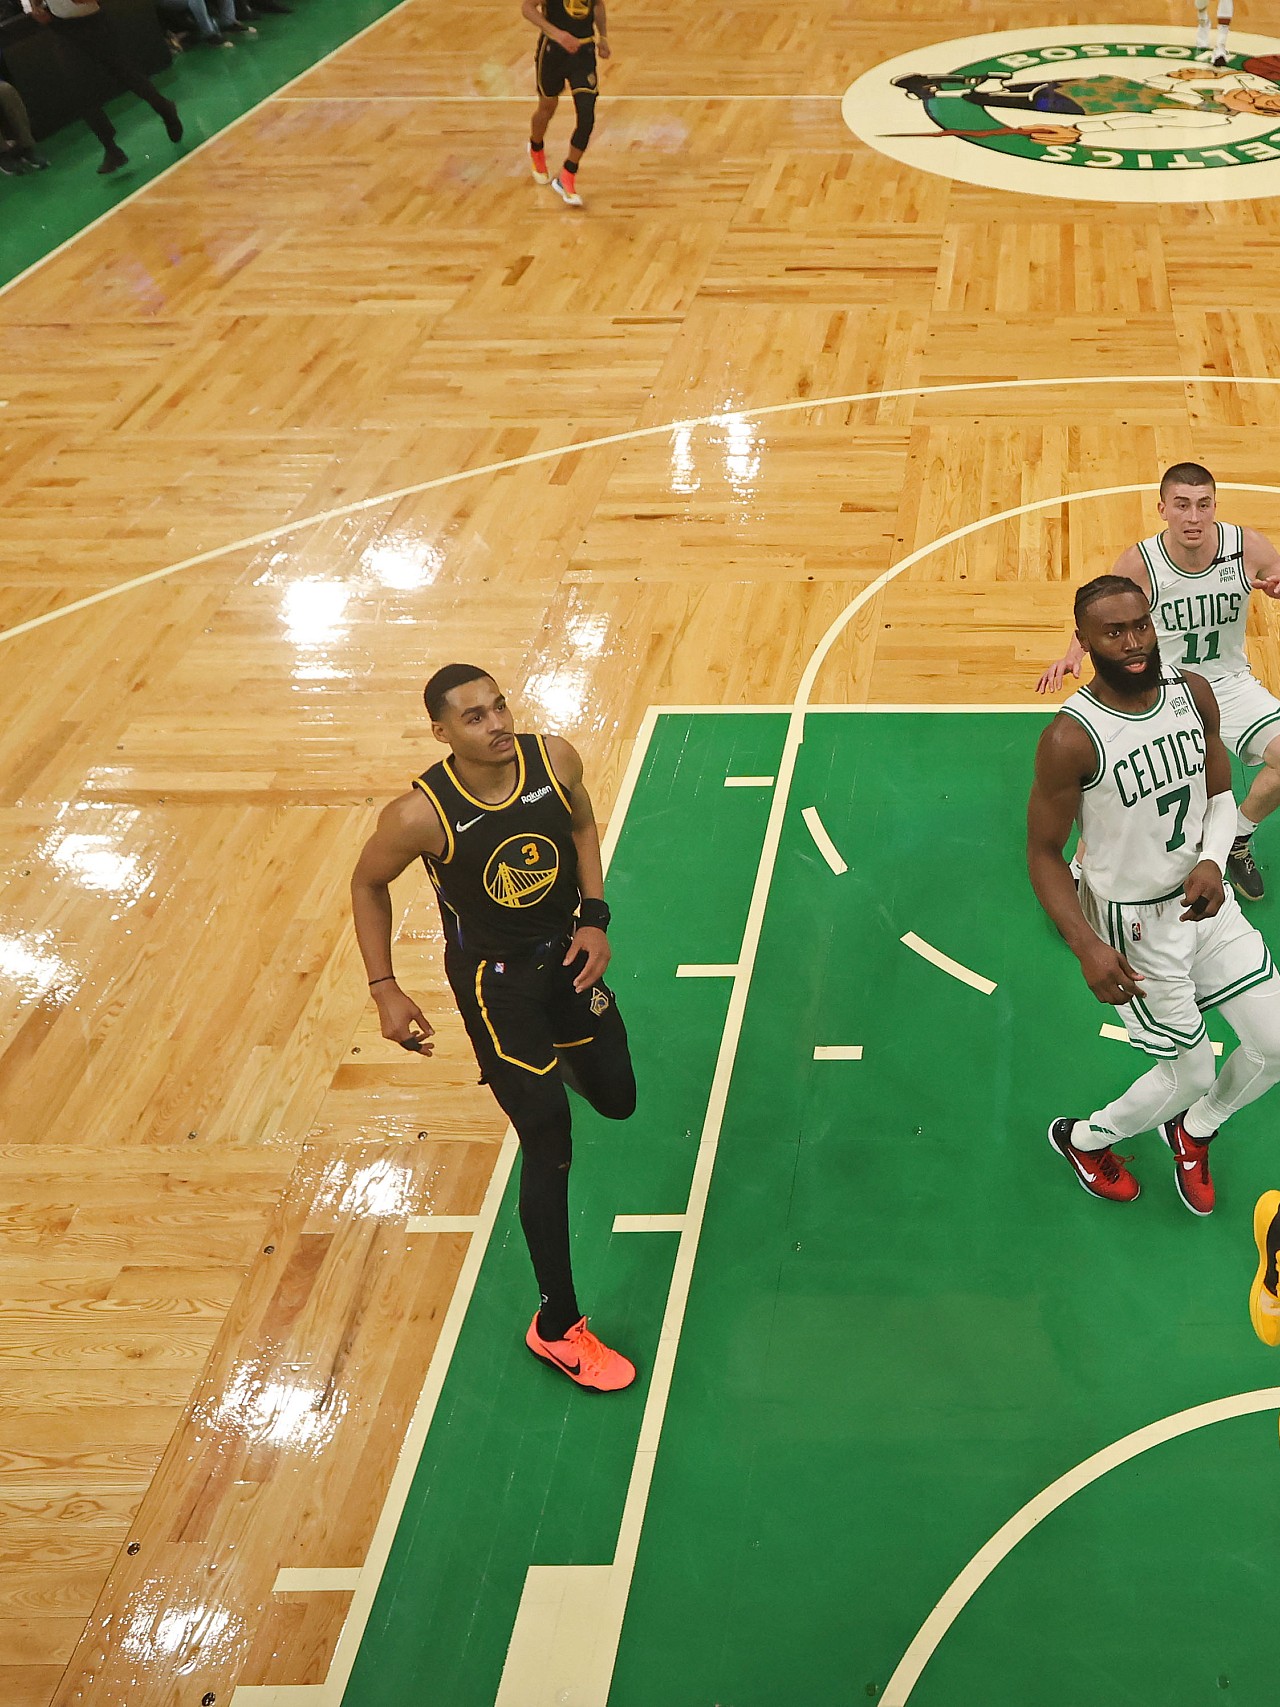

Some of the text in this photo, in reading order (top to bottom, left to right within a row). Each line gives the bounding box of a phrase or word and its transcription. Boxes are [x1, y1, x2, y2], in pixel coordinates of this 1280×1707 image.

[1219, 566, 1236, 577] VISTA
[1161, 592, 1241, 631] CELTICS
[1181, 631, 1220, 664] 11
[1169, 696, 1187, 710] VISTA
[1174, 705, 1190, 717] PRINT
[1113, 728, 1205, 808] CELTICS
[521, 785, 552, 804] Rakuten
[1156, 785, 1191, 852] 7
[521, 842, 540, 866] 3
